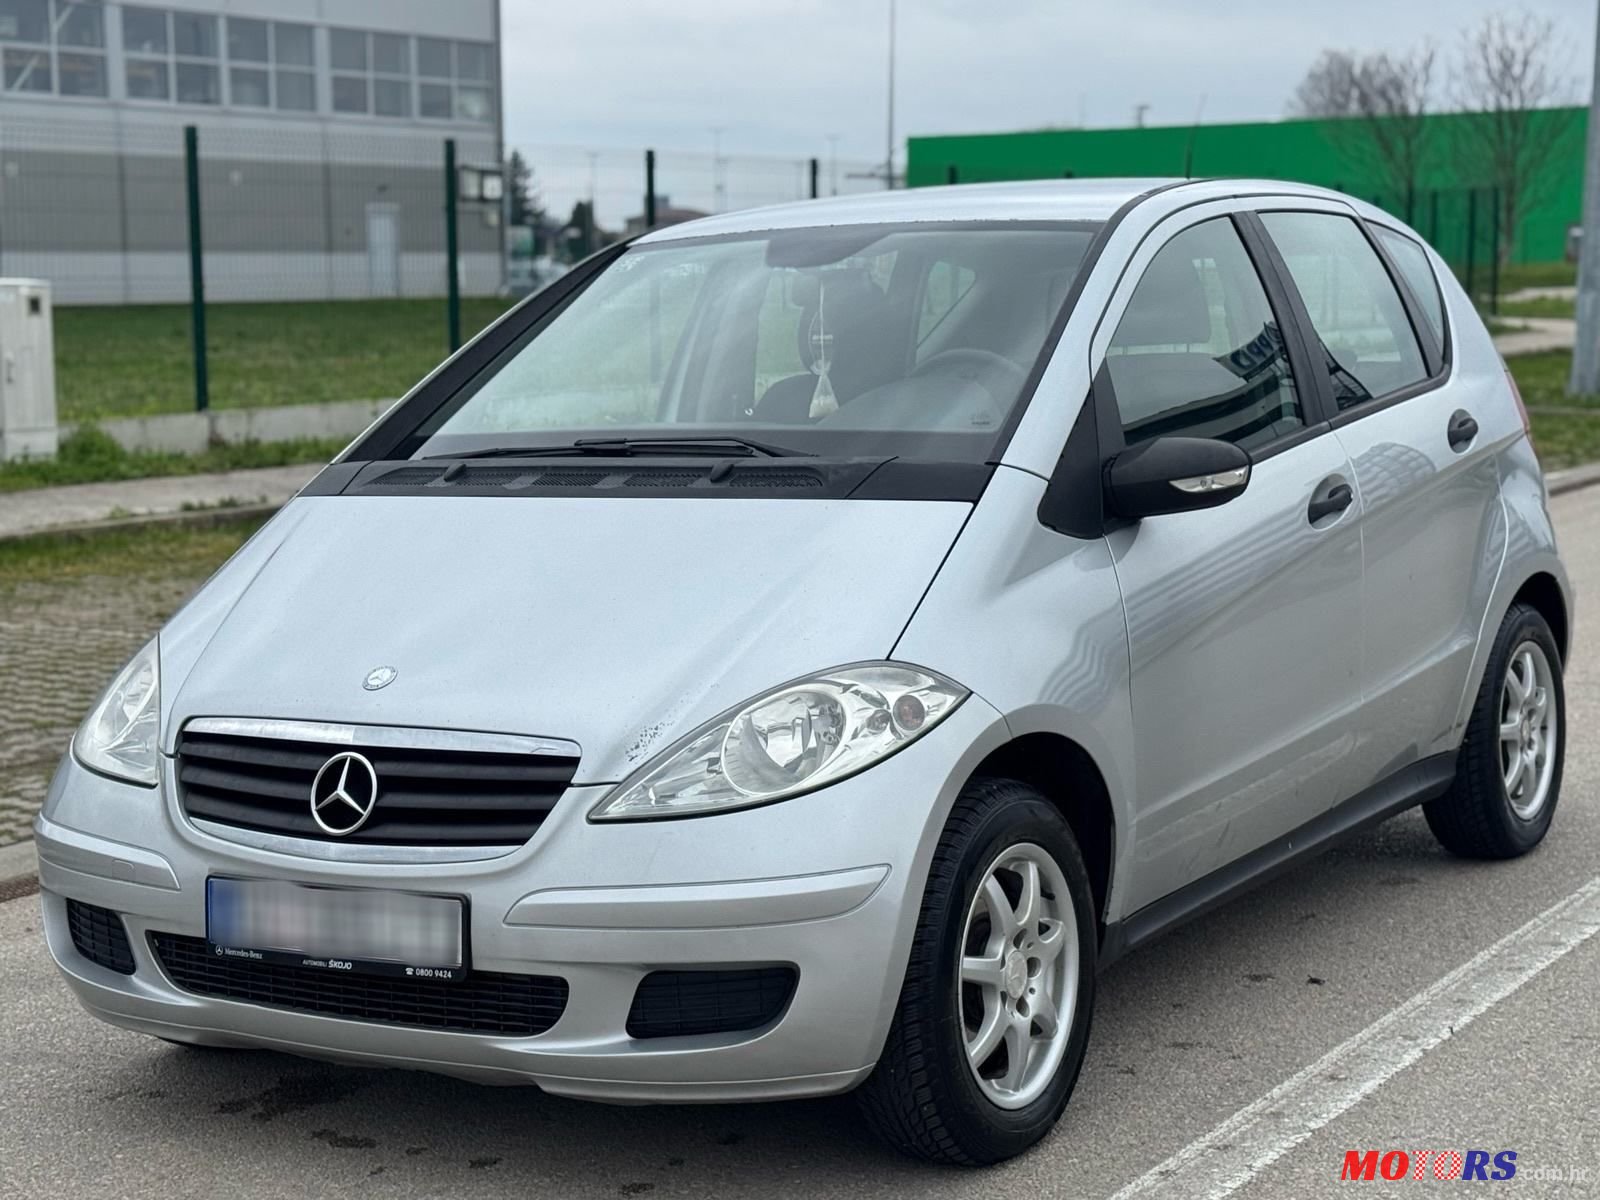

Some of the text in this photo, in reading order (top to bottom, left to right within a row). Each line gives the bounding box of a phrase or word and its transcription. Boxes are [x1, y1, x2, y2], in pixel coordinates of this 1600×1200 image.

[224, 948, 263, 959] Mercedes-Benz
[328, 958, 353, 970] ŠKOJO
[415, 967, 452, 979] 0800 9424
